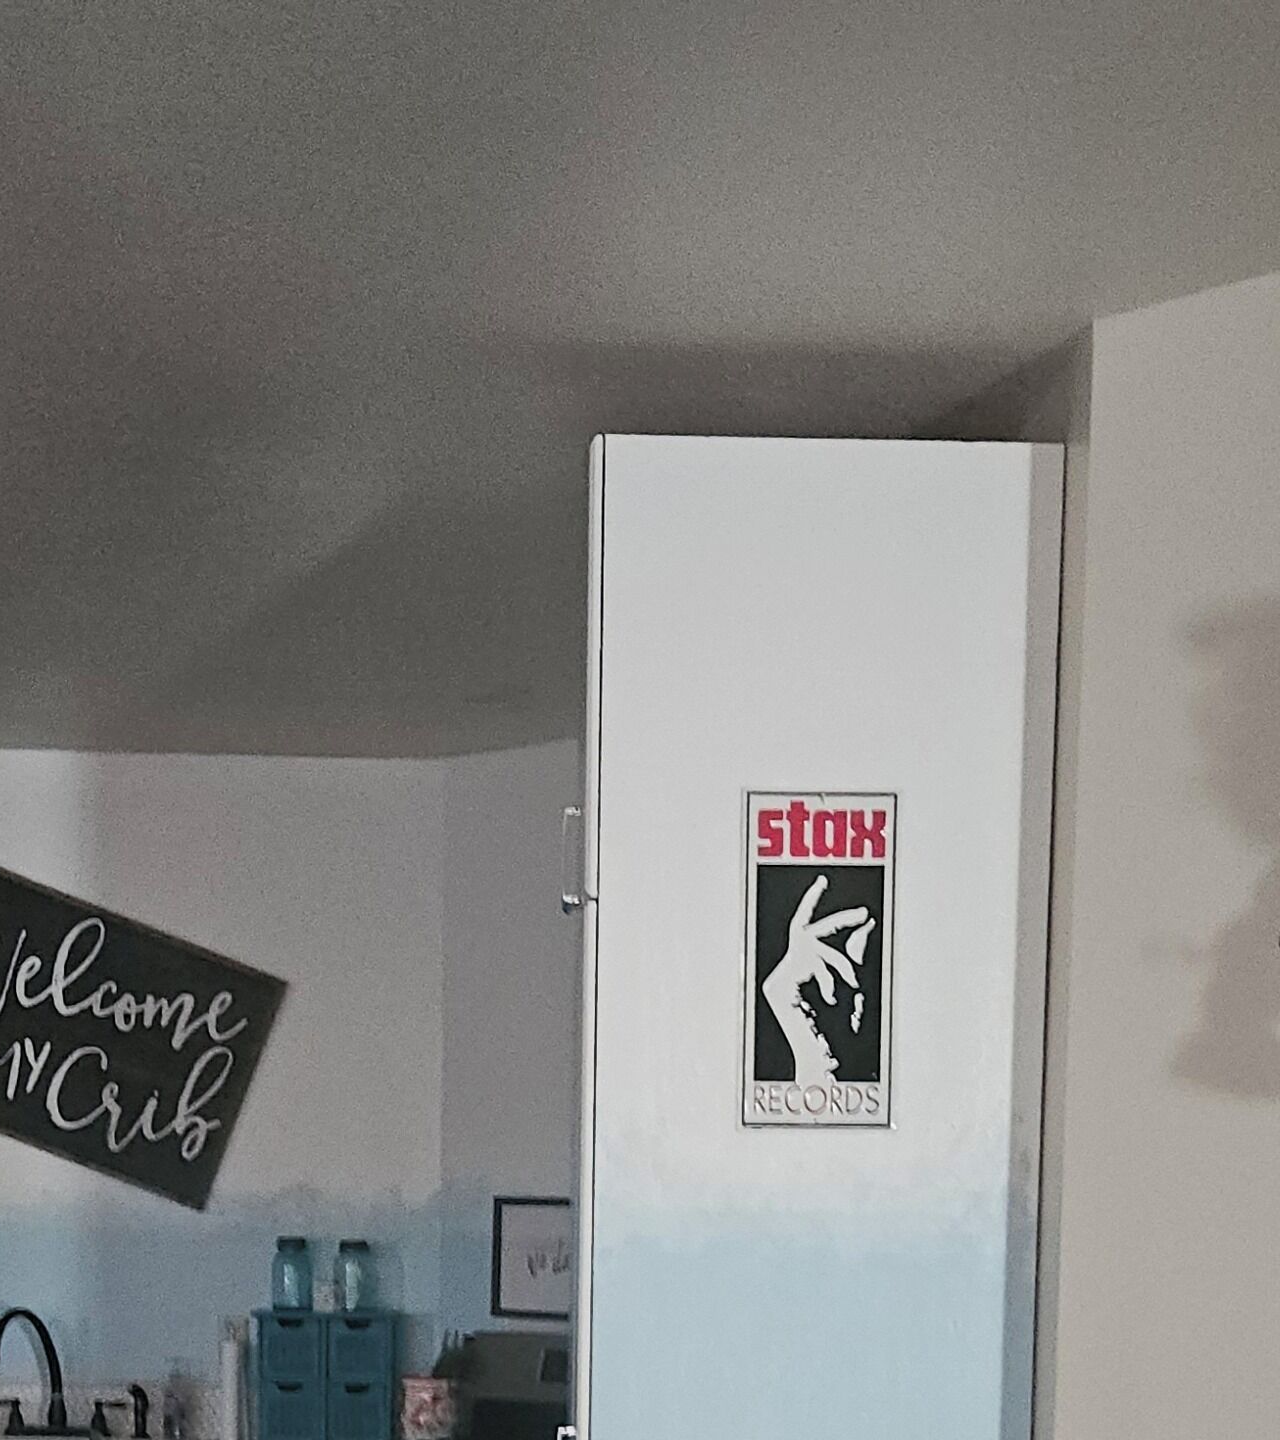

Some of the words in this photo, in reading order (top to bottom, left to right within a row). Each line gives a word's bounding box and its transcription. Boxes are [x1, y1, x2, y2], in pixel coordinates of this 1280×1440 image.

[756, 800, 887, 858] stax
[45, 1045, 234, 1161] Crib
[752, 1084, 881, 1116] RECORDS
